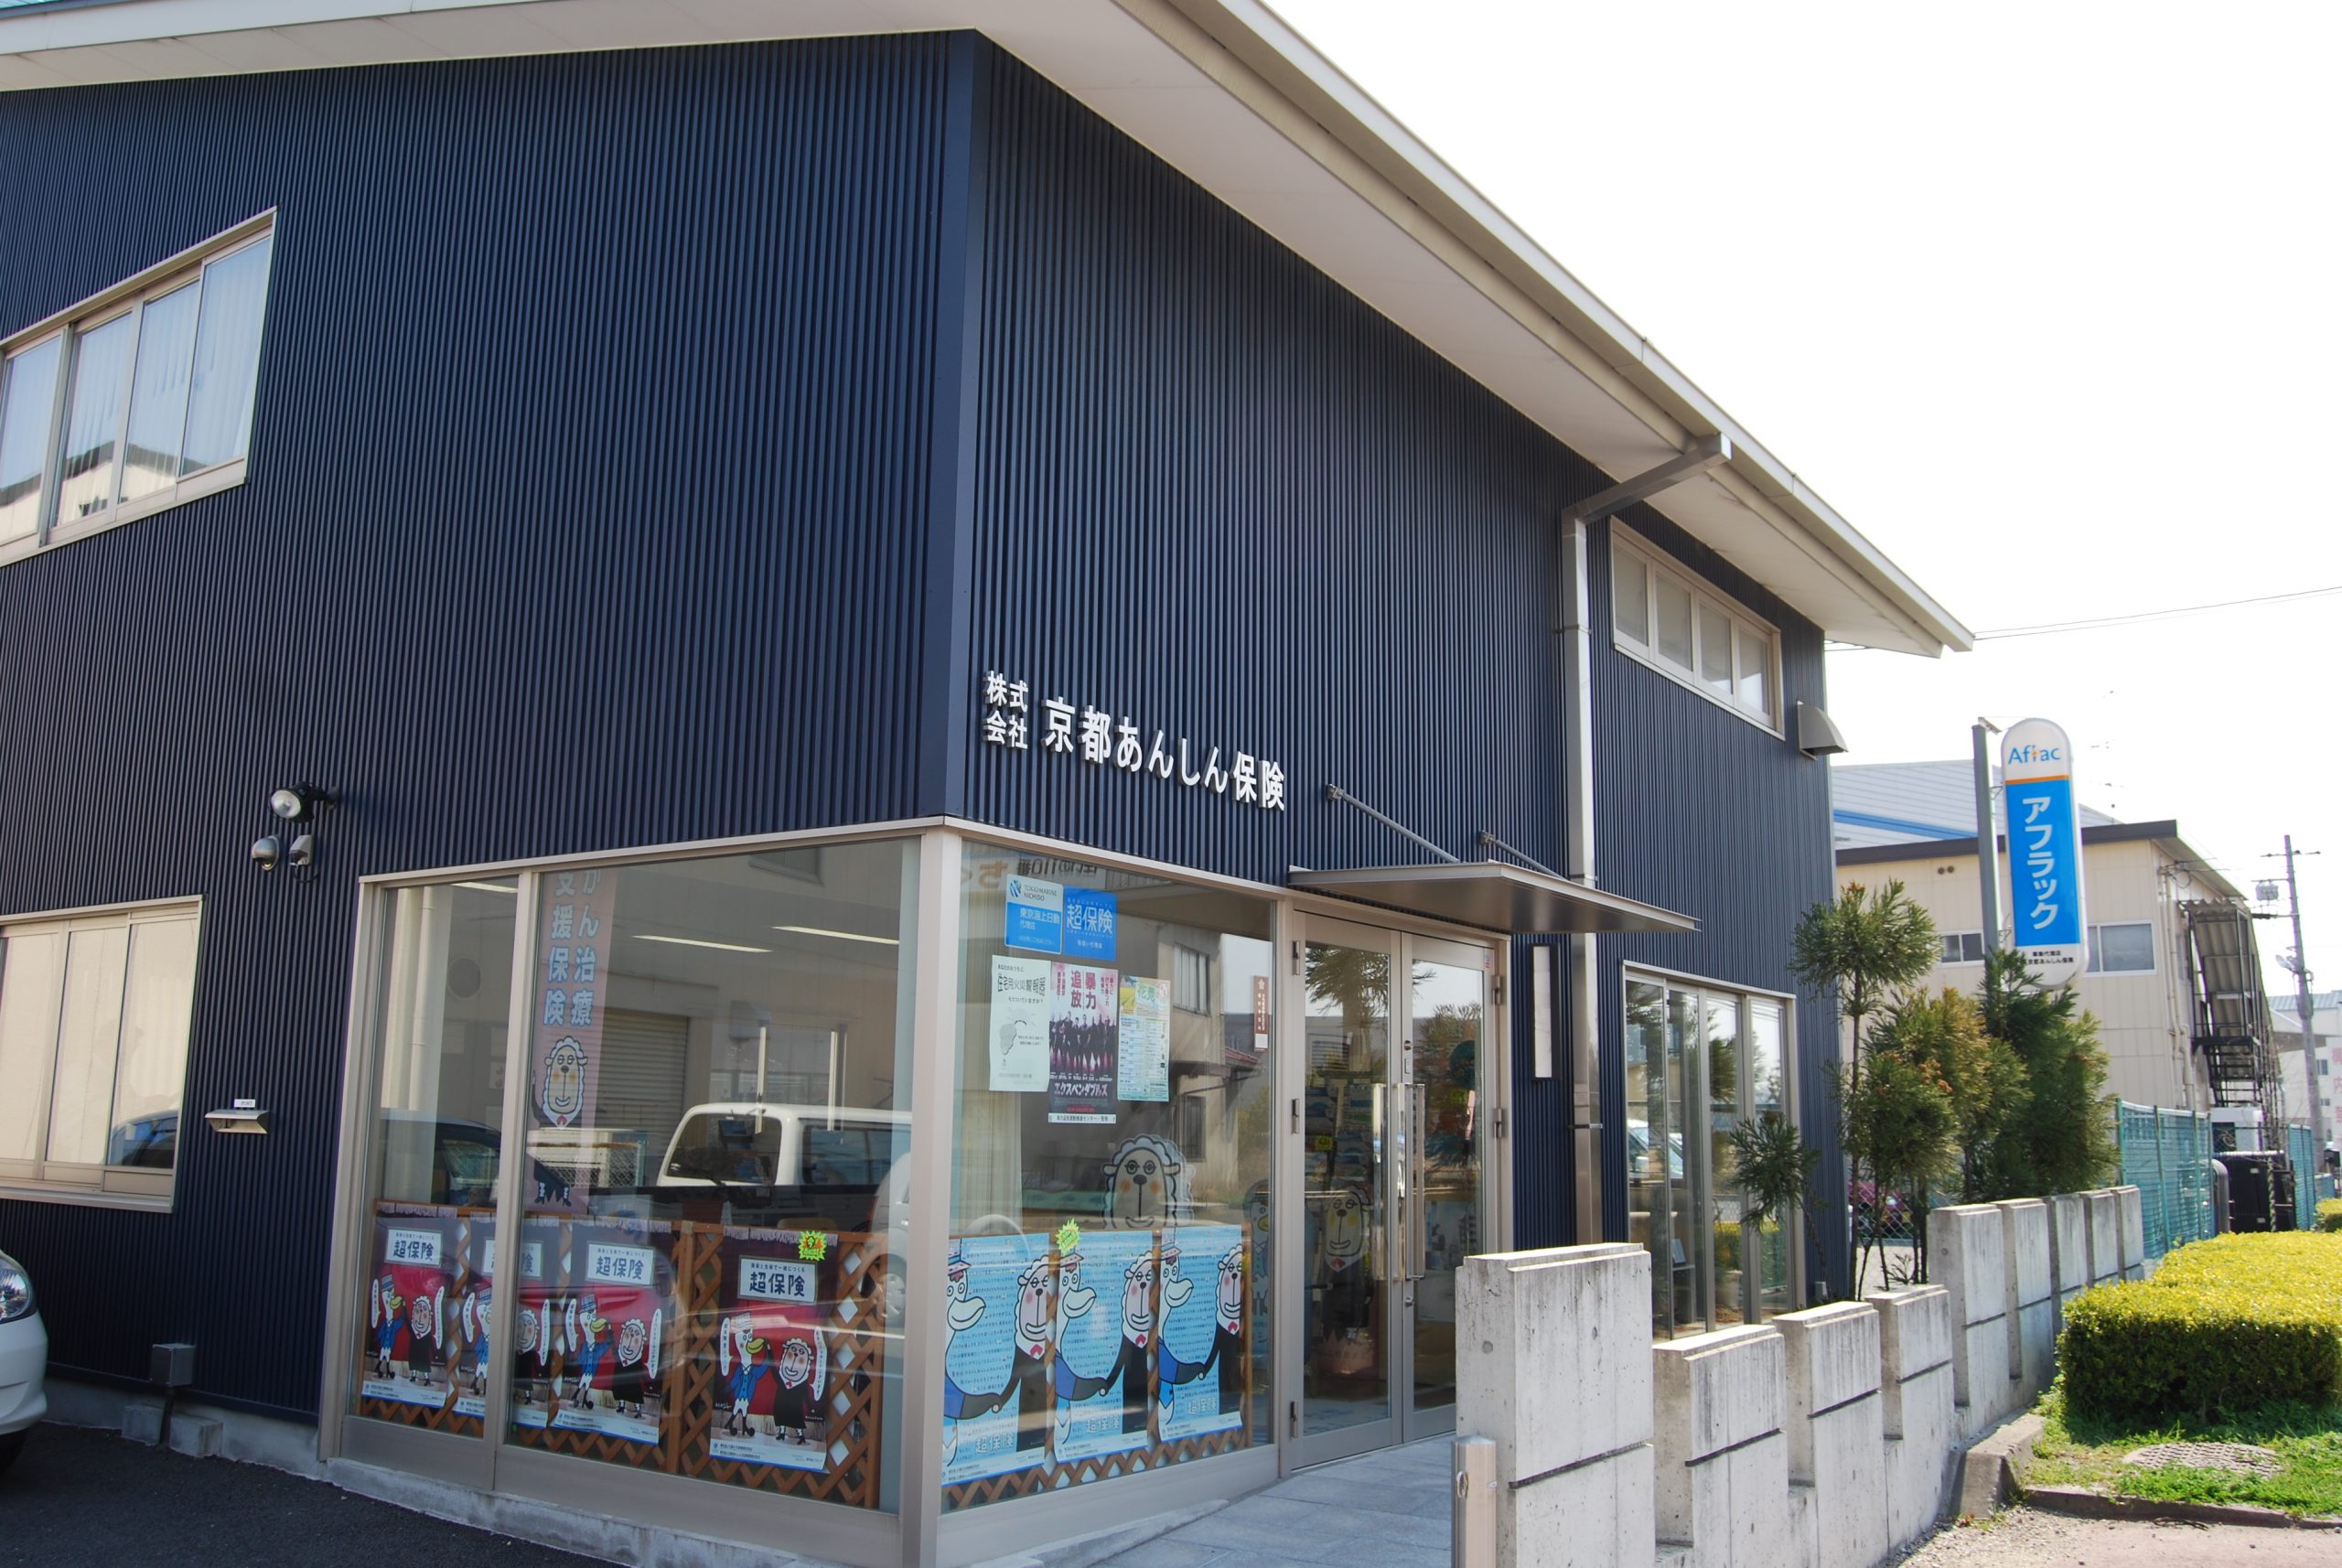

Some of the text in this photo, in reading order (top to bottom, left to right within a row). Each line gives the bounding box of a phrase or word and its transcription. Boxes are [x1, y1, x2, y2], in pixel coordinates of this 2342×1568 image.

[985, 671, 1028, 713] 株式
[984, 710, 1028, 749] 会社
[1042, 696, 1284, 811] 京都あんしん保険
[2008, 745, 2061, 765] Aflac
[2022, 796, 2058, 930] アフラック
[1020, 908, 1060, 924] 東京海上日動
[1067, 903, 1113, 934] 超保険
[543, 873, 575, 1026] 支援保険
[1070, 970, 1081, 1008] 追放
[1085, 972, 1096, 1010] 暴力
[393, 1240, 434, 1262] 超保険
[596, 1256, 644, 1280] 超保険
[749, 1272, 805, 1297] 超保険
[1187, 1397, 1216, 1414] 超保険
[1086, 1414, 1120, 1434] 超保険
[975, 1433, 1014, 1453] 超保険
